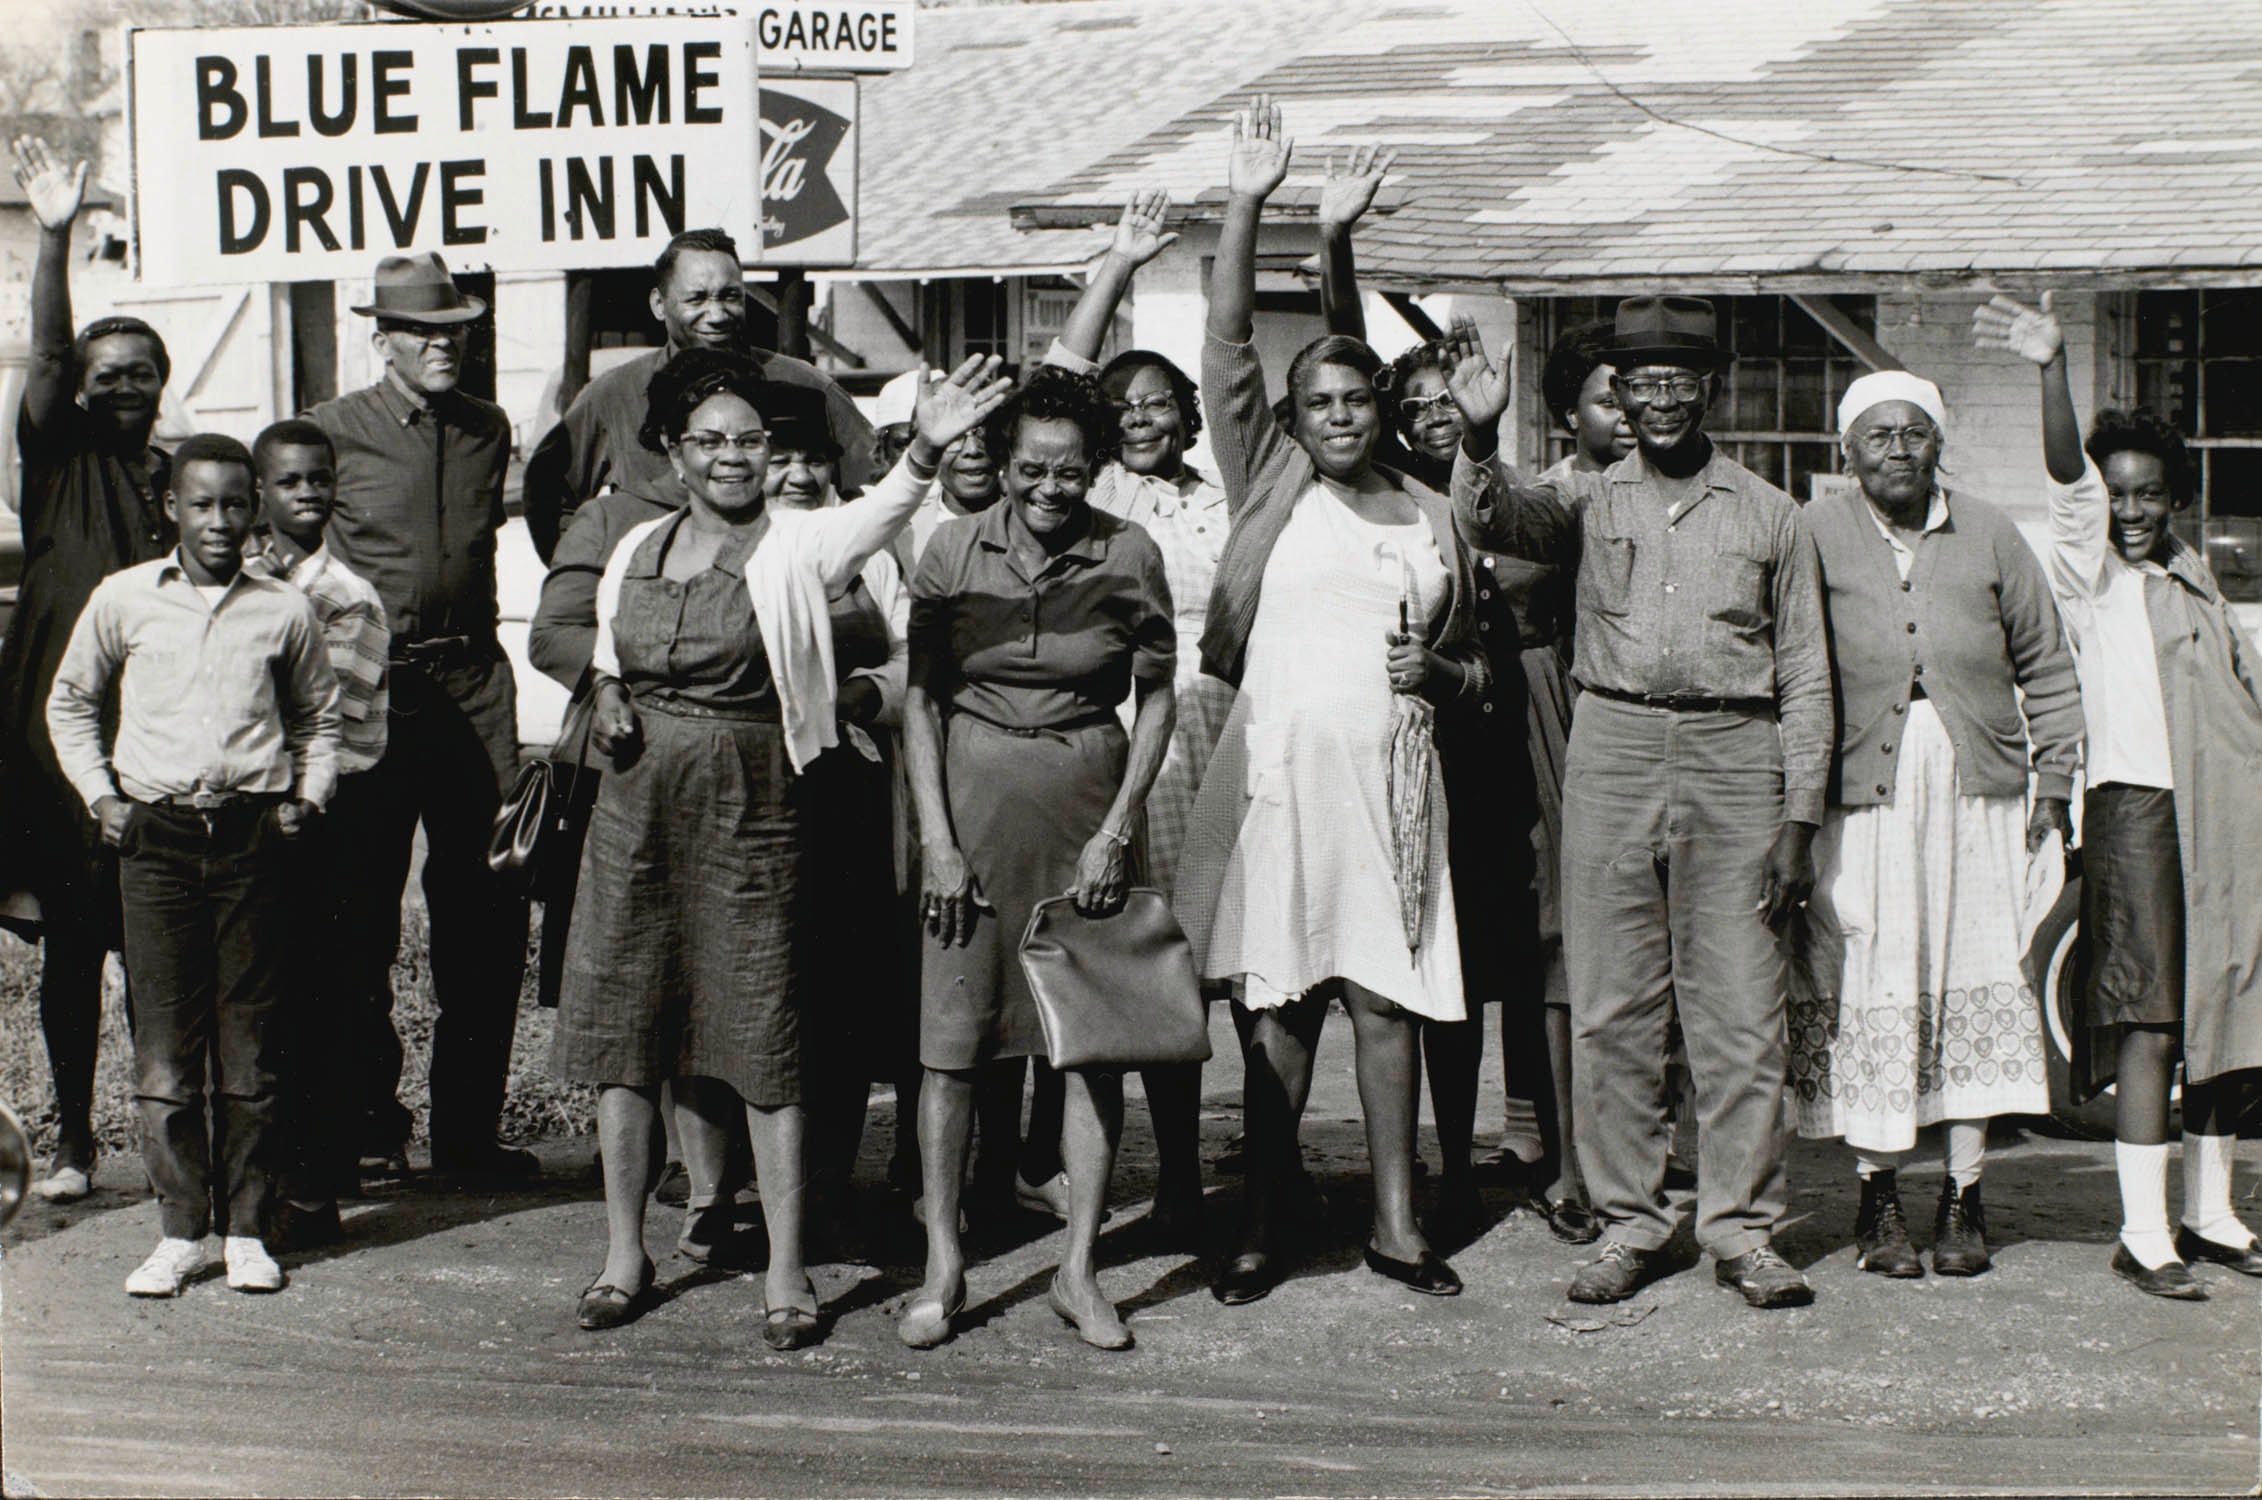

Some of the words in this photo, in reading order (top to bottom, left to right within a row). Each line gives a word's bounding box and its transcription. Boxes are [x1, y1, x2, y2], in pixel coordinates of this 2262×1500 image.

[758, 8, 898, 53] GARAGE
[196, 50, 419, 141] BLUE
[456, 41, 724, 132] FLAME
[217, 159, 488, 256] DRIVE
[539, 154, 687, 242] INN
[760, 118, 816, 201] la
